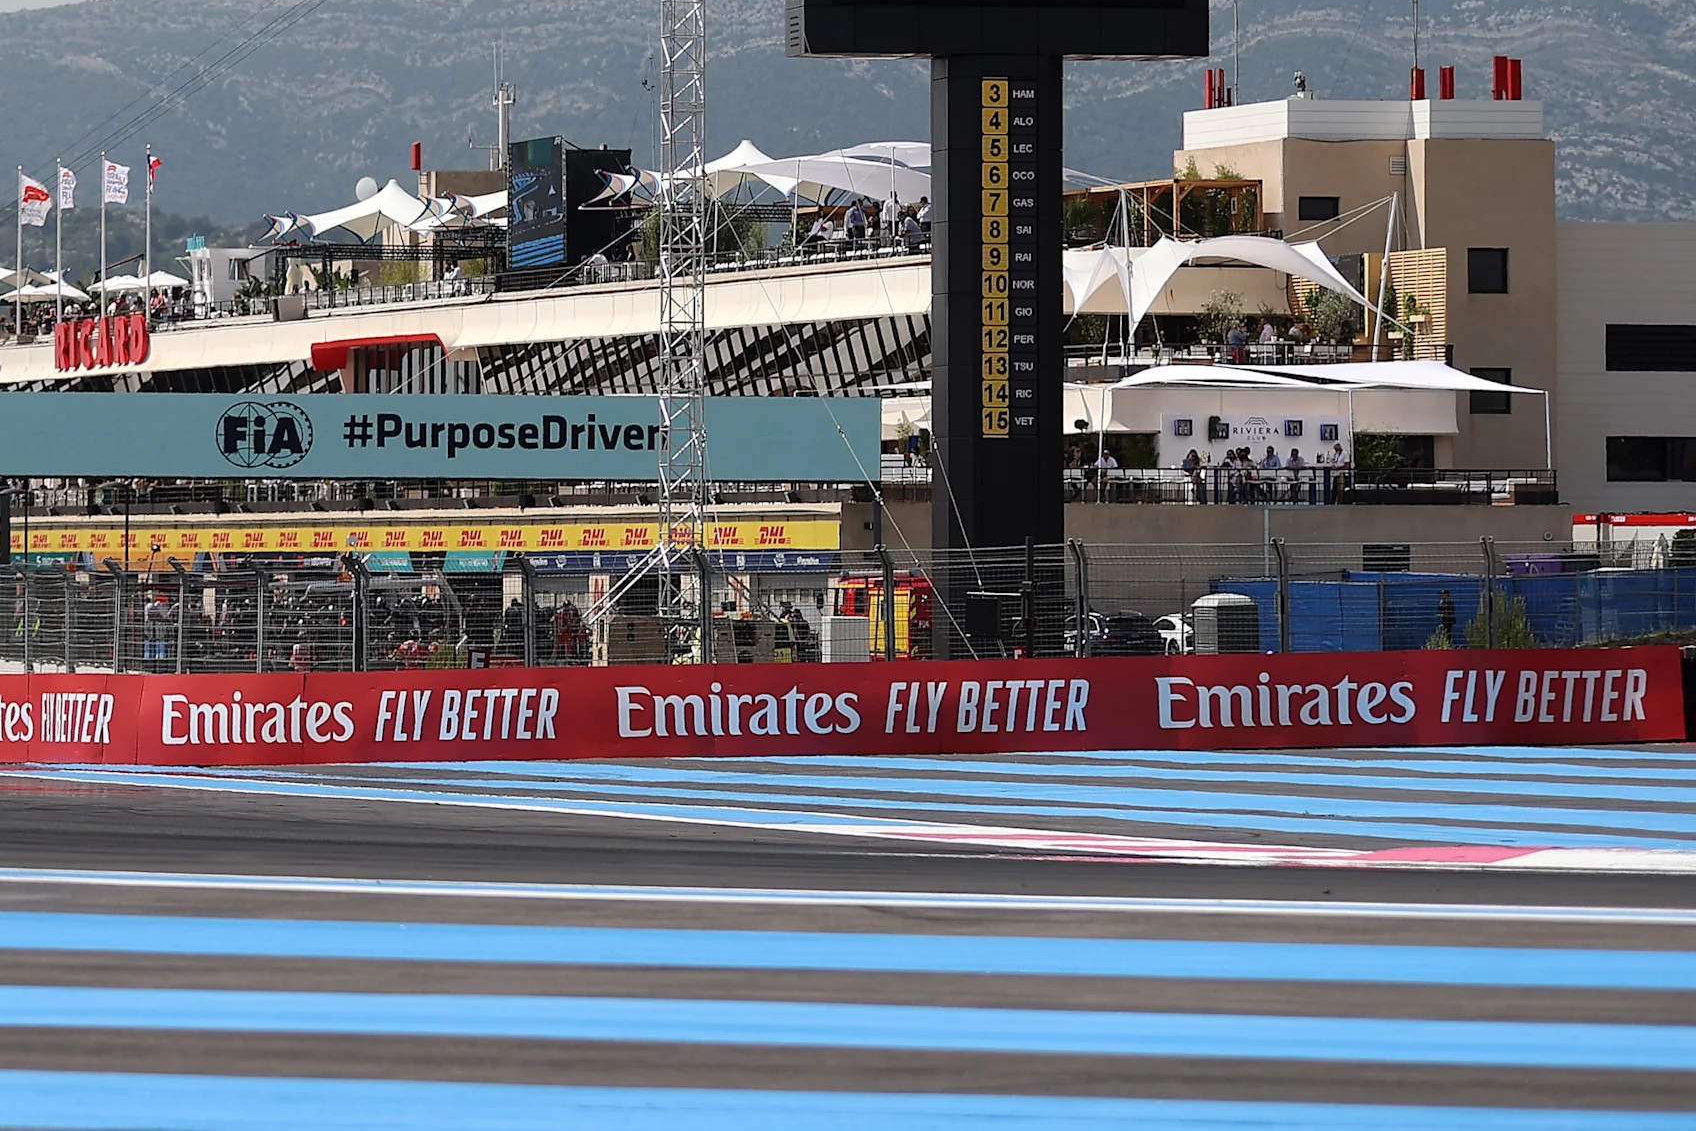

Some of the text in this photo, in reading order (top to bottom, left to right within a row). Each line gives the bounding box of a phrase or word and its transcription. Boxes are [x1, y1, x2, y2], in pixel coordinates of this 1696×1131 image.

[988, 84, 1035, 102] 3 HAM
[989, 112, 1034, 129] 4 ALO
[989, 139, 1033, 157] 5 LEC
[989, 166, 1035, 183] 6 OCO
[989, 193, 1034, 211] 7 GAS
[989, 221, 1032, 238] 8 SAI
[989, 248, 1032, 266] 9 RAI
[984, 275, 1035, 293] 10 NOR
[984, 302, 1033, 320] 11 GIO
[55, 314, 148, 369] RICARD
[984, 329, 1035, 348] 12 PER
[984, 357, 1034, 375] 13 TSU
[984, 384, 1033, 402] 14 RIC
[984, 411, 1035, 429] 15 VET
[1232, 427, 1279, 435] RIVIERA
[313, 532, 333, 547] DHL
[385, 532, 405, 547] DHL
[423, 531, 443, 547] DHL
[461, 531, 482, 547] DHL
[500, 531, 522, 547] DHL
[541, 530, 563, 546] DHL
[583, 529, 605, 545] DHL
[625, 528, 649, 545] DHL
[713, 527, 738, 545] DHL
[759, 526, 786, 545] DHL
[1155, 669, 1646, 728] Emirates FLY BETTER
[162, 689, 559, 744] Emirates FLY BETTER
[615, 679, 1089, 737] Emirates FLY BETTER
[55, 693, 114, 744] BETTER
